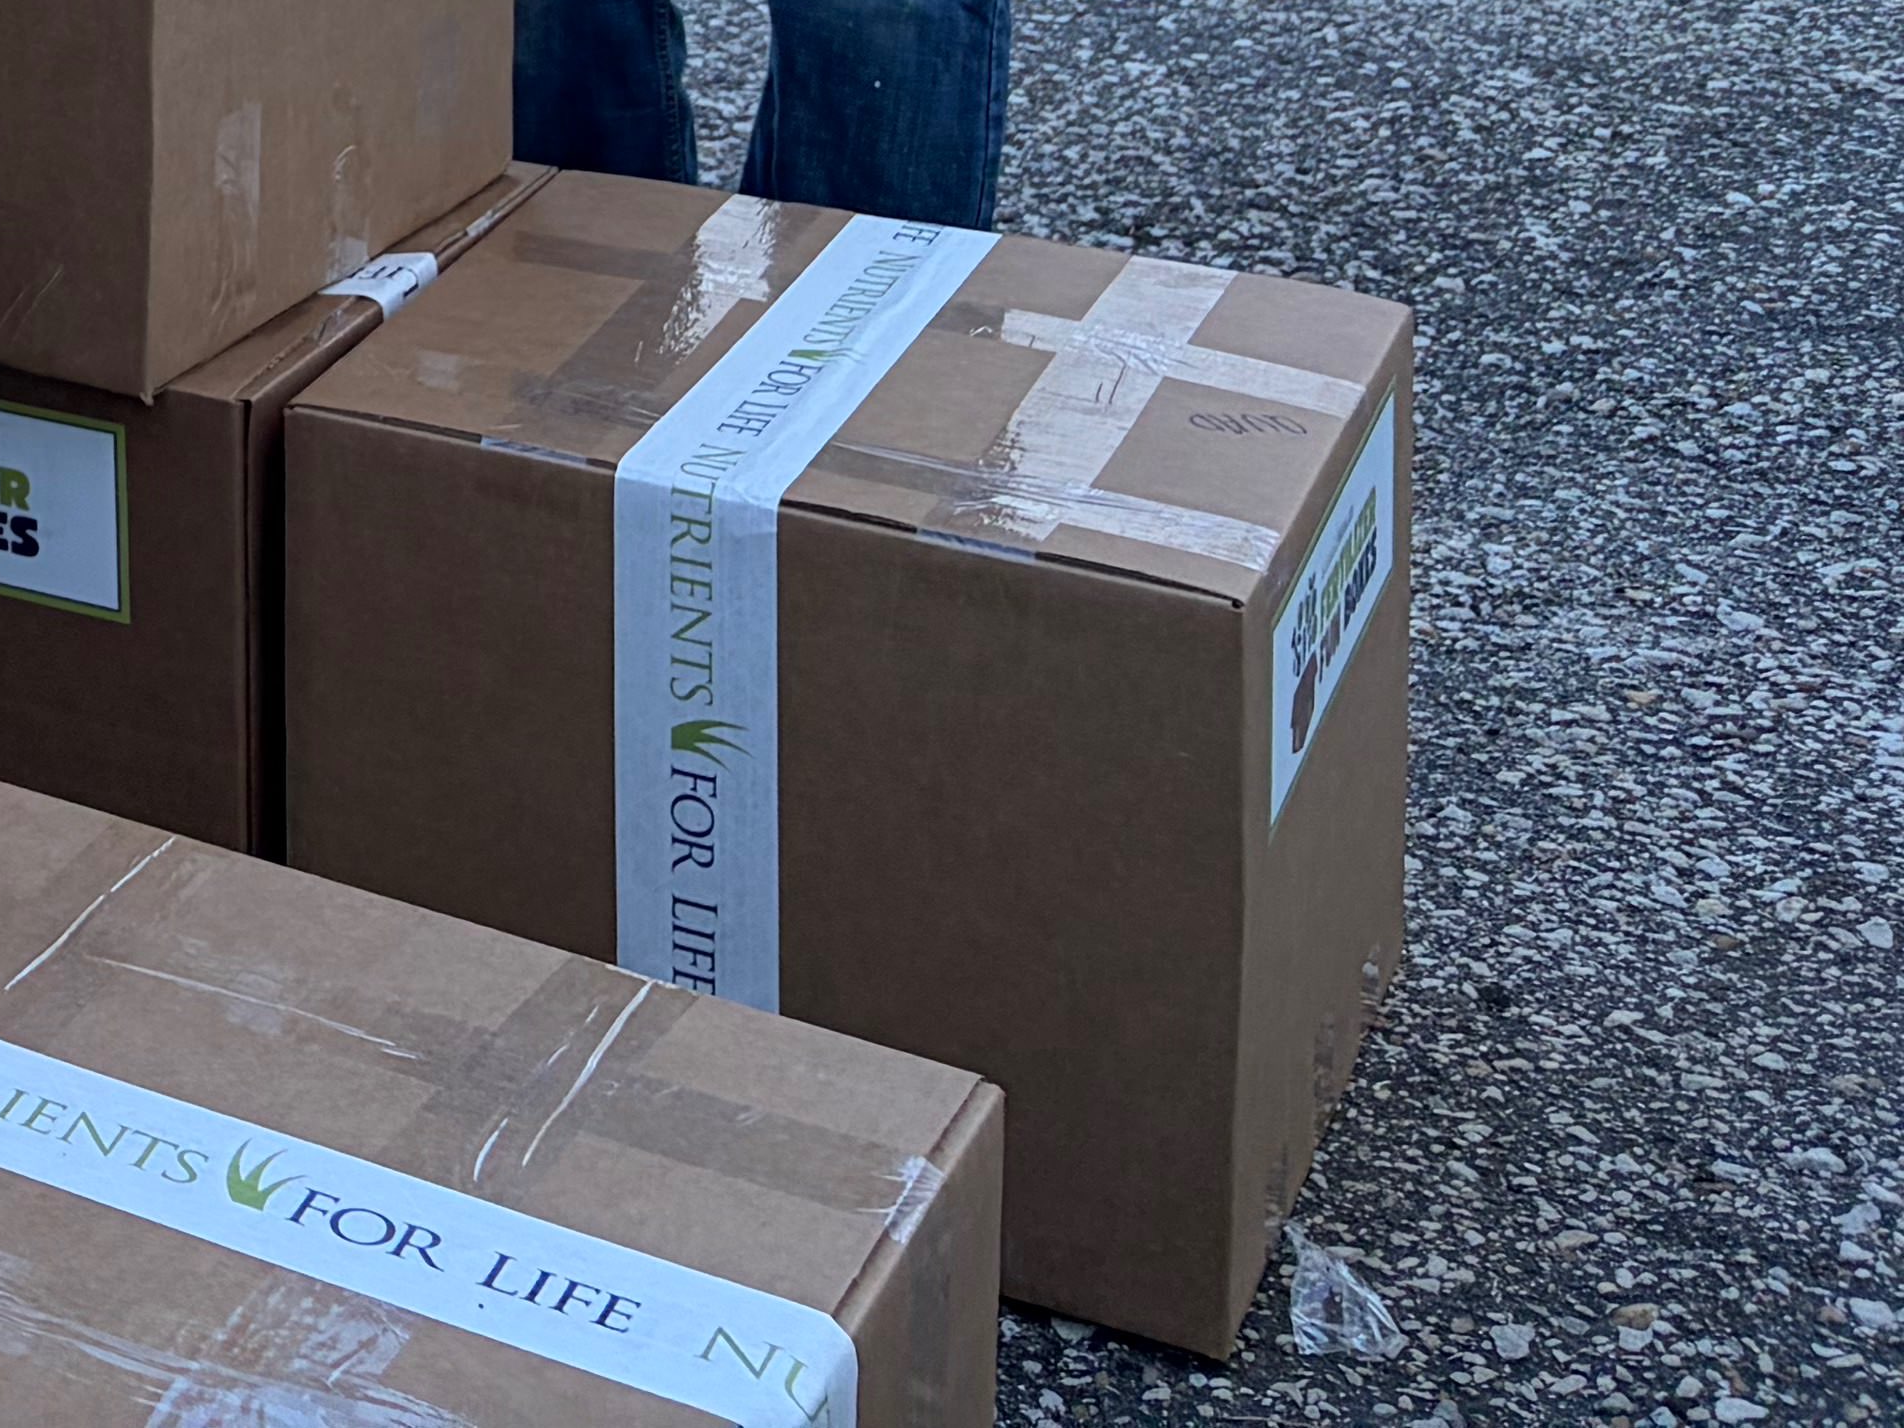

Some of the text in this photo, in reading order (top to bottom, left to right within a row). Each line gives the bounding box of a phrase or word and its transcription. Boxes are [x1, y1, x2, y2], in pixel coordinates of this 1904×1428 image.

[802, 249, 923, 352] NUTRIENTS
[716, 399, 790, 438] LIFE
[752, 359, 823, 396] FOR
[670, 443, 747, 707] NUTRIENTS
[670, 762, 718, 873] FOR
[671, 893, 719, 996] LIFE
[283, 1185, 446, 1274] FOR
[475, 1251, 643, 1335] LIFE
